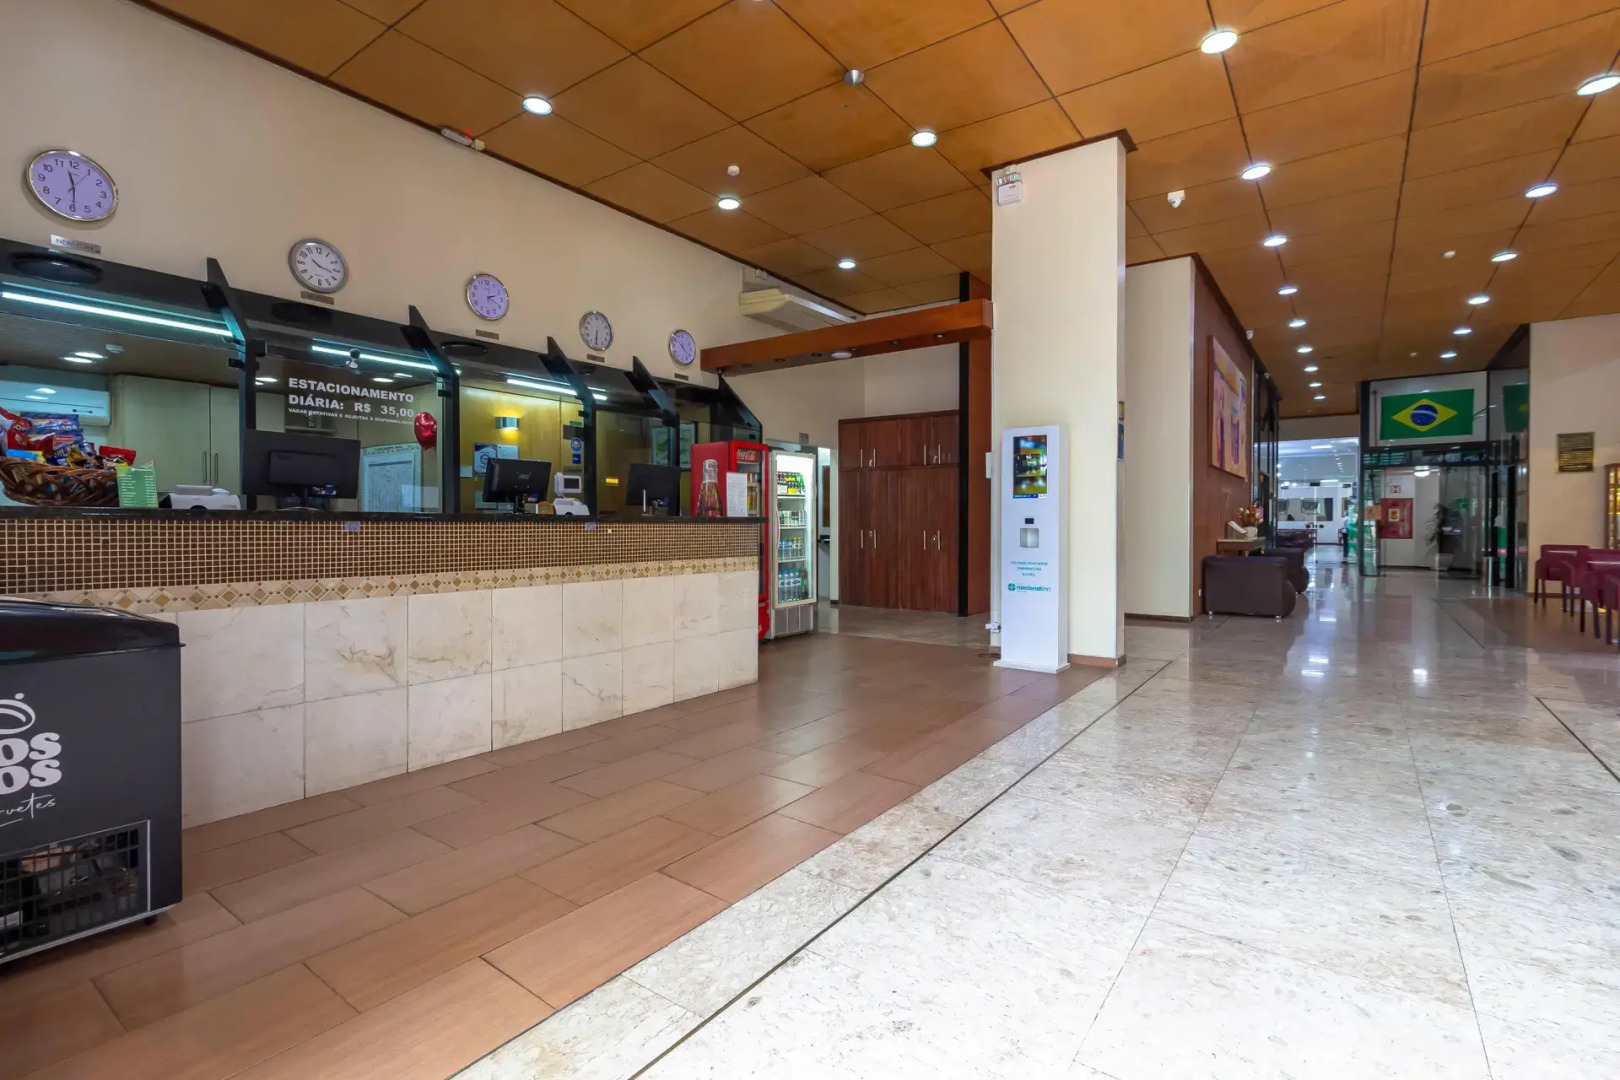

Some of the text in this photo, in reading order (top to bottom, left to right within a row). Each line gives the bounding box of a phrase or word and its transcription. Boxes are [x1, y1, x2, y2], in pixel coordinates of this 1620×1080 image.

[43, 164, 53, 172] 10
[55, 159, 63, 167] 11
[69, 161, 79, 169] 12
[289, 378, 414, 402] ESTACIONAMENTO
[289, 394, 414, 417] DIÁRIA: R$ 35,00
[0, 793, 56, 819] vetes
